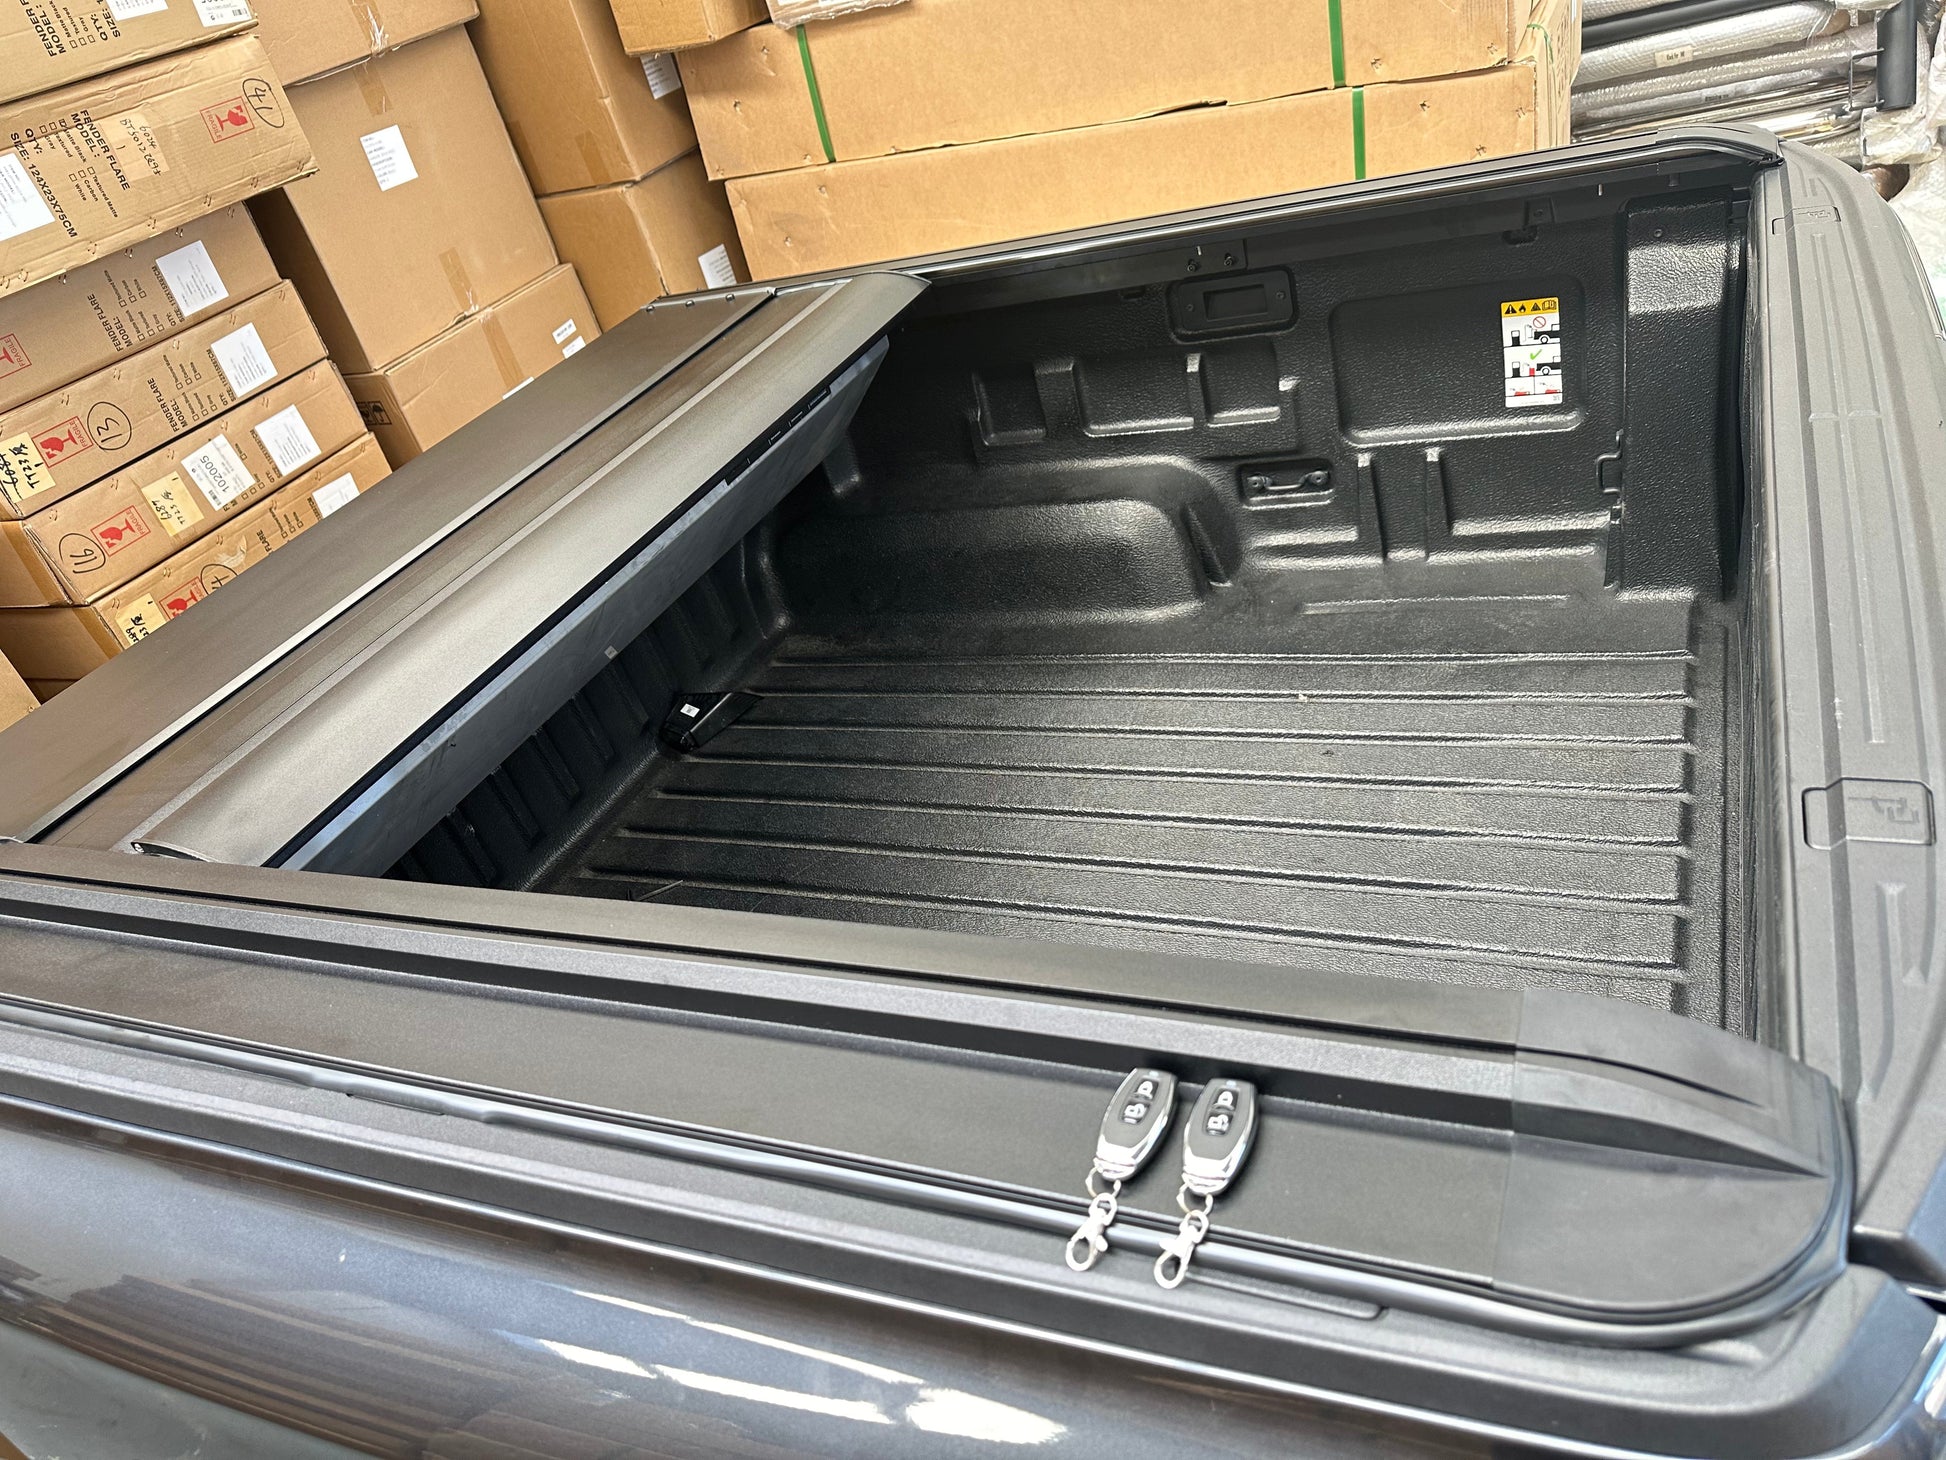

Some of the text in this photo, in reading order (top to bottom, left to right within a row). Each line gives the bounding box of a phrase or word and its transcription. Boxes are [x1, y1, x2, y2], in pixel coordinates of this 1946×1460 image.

[25, 7, 57, 57] FENDER
[58, 18, 71, 38] Matte
[62, 6, 80, 34] Textured
[77, 15, 89, 32] Gray
[89, 12, 108, 41] QTY:
[100, 7, 121, 38] SIZE:
[22, 126, 44, 155] QTY:
[74, 145, 87, 162] Black
[79, 109, 130, 190] FENDER FLARE
[8, 131, 32, 161] SIZE:
[27, 163, 77, 238] 124X23X75CM
[74, 183, 87, 201] White
[83, 179, 99, 201] Carbon
[91, 175, 118, 217] Textured Matte
[86, 293, 123, 351] FENDER FLARE
[111, 315, 133, 347] MODEL:
[4, 337, 25, 366] FRAGILE
[147, 377, 180, 432] FENDER FLARE
[168, 398, 188, 427] MODEL:
[69, 420, 87, 447] FRAGILE
[92, 414, 124, 444] 13
[199, 454, 229, 492] 102005
[126, 509, 145, 534] FRAGILE
[255, 528, 272, 552] FLARE
